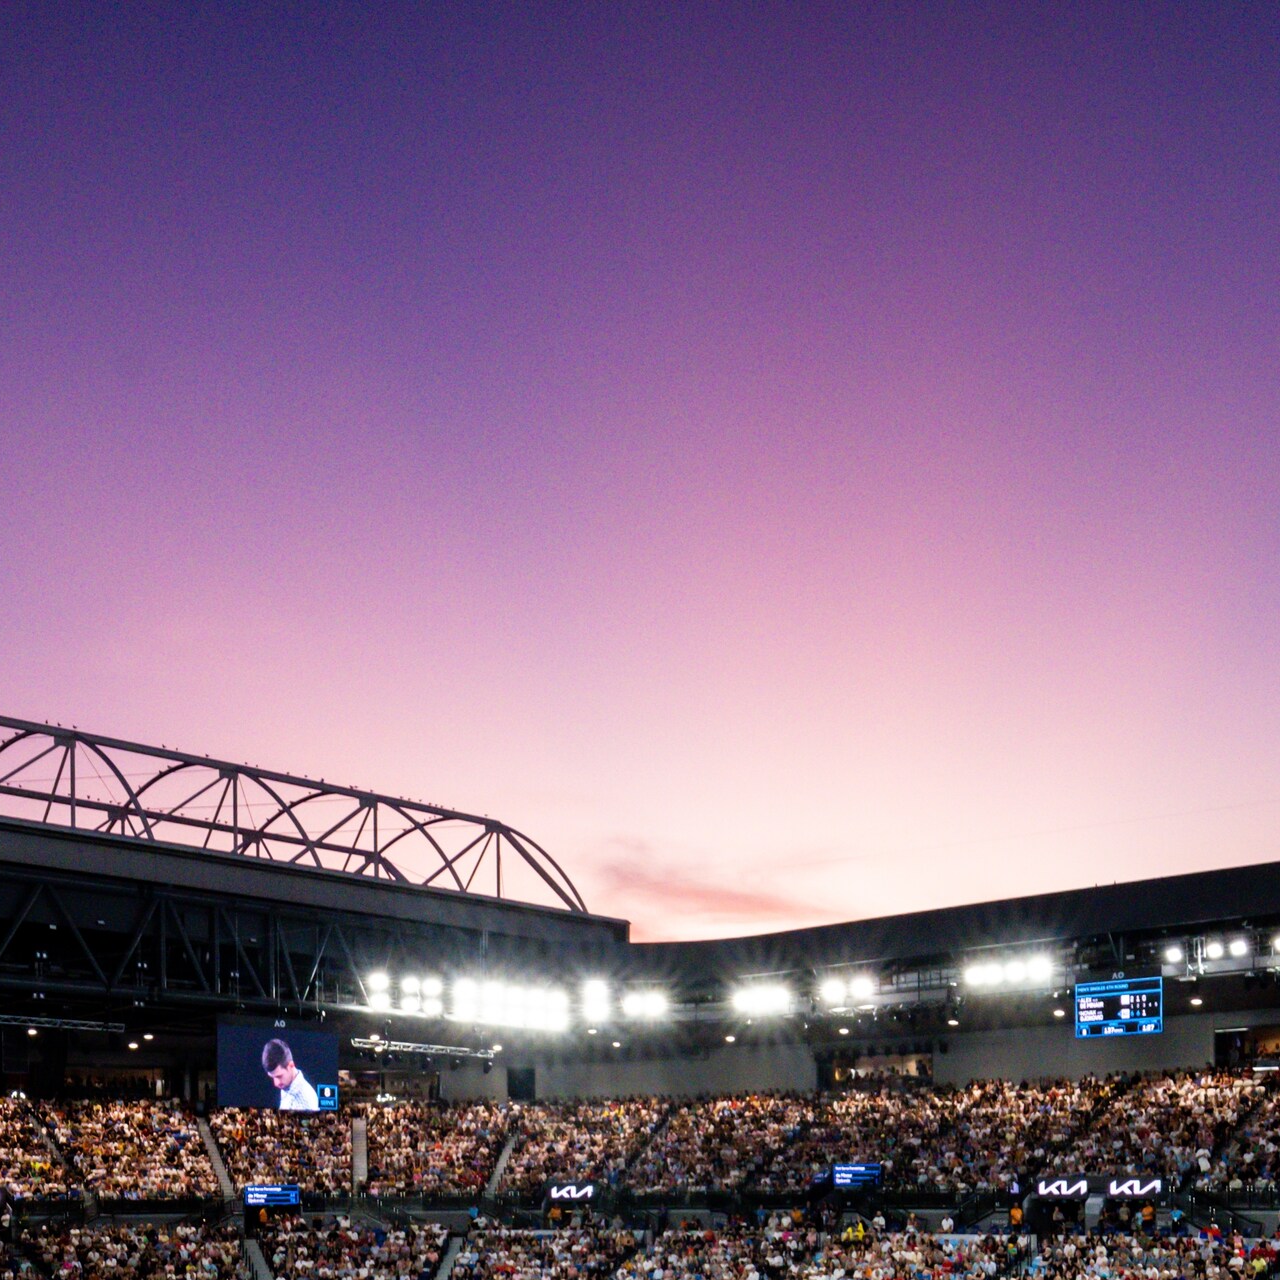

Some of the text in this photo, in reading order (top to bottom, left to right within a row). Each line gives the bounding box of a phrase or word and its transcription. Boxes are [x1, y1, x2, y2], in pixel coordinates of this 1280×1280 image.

[551, 1185, 593, 1198] KIA
[1038, 1180, 1087, 1195] KIA
[1110, 1179, 1161, 1195] KIA
